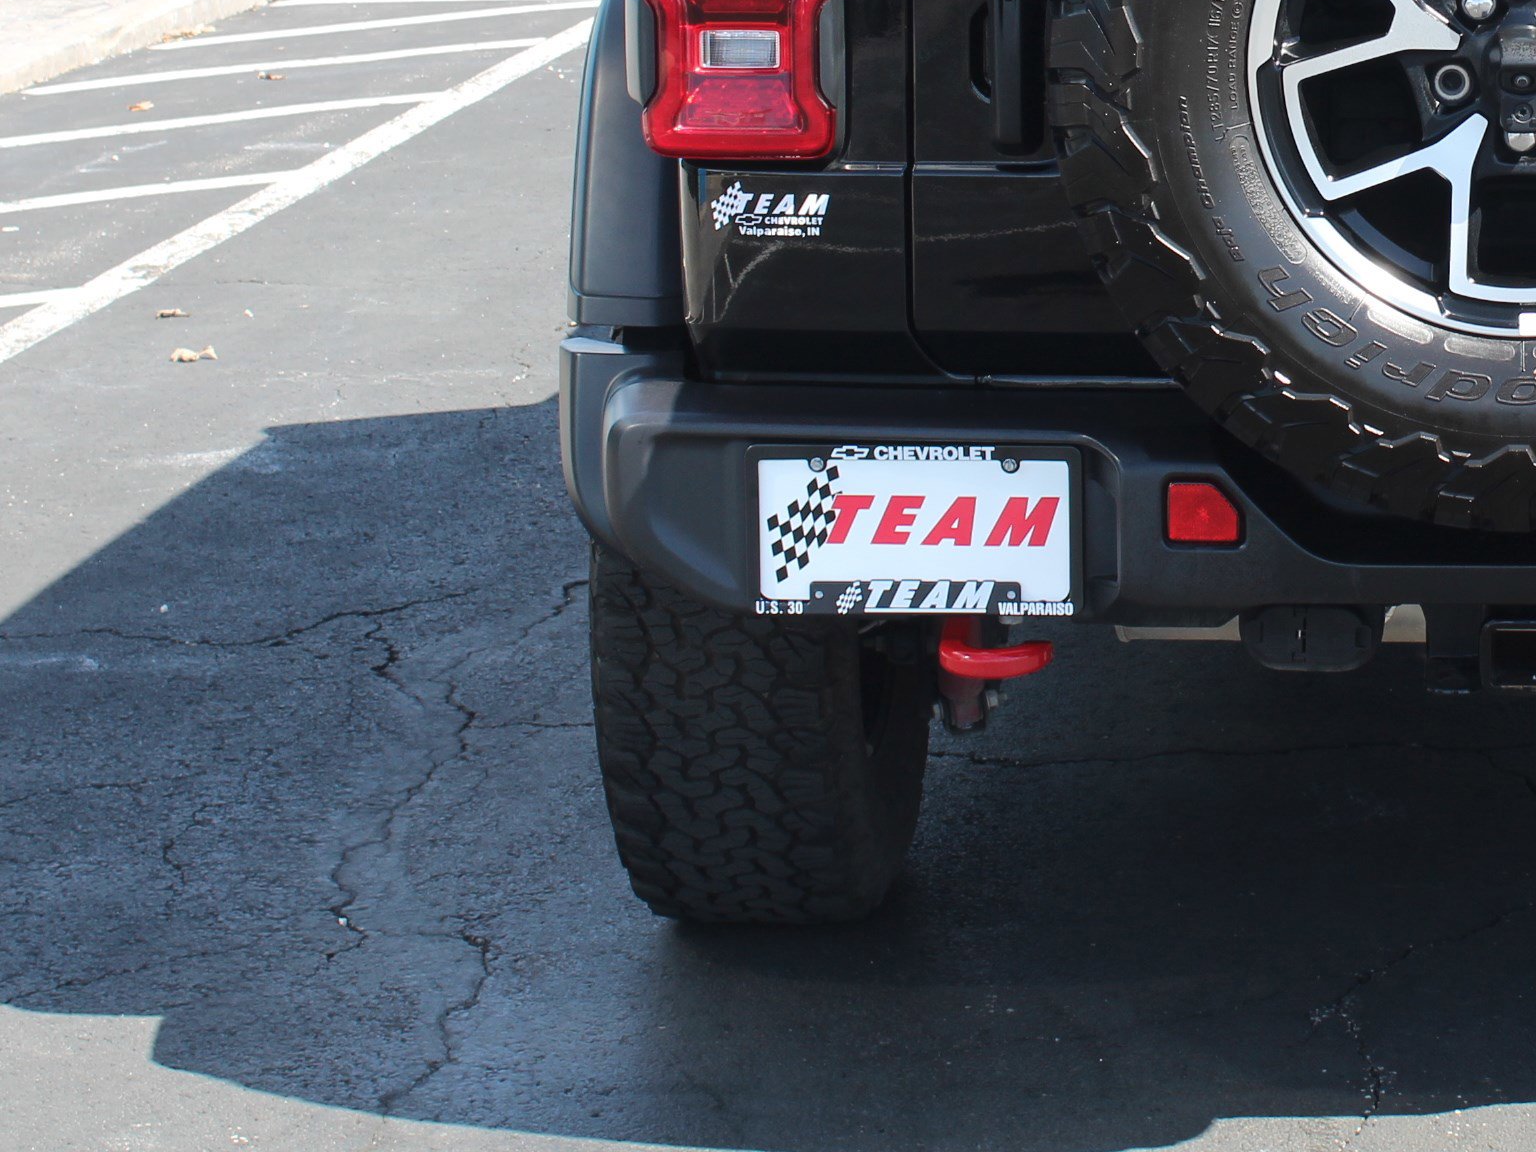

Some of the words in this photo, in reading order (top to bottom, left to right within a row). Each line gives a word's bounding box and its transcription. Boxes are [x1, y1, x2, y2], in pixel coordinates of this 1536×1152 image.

[735, 193, 830, 216] TEAM
[764, 216, 824, 225] CHEVROLET
[807, 226, 821, 236] IN
[872, 445, 996, 461] CHEVROLET
[826, 494, 1061, 547] TEAM
[865, 580, 995, 610] TEAM
[755, 600, 785, 615] U.S.
[787, 600, 804, 615] 30
[998, 601, 1074, 616] VALPARAISO
